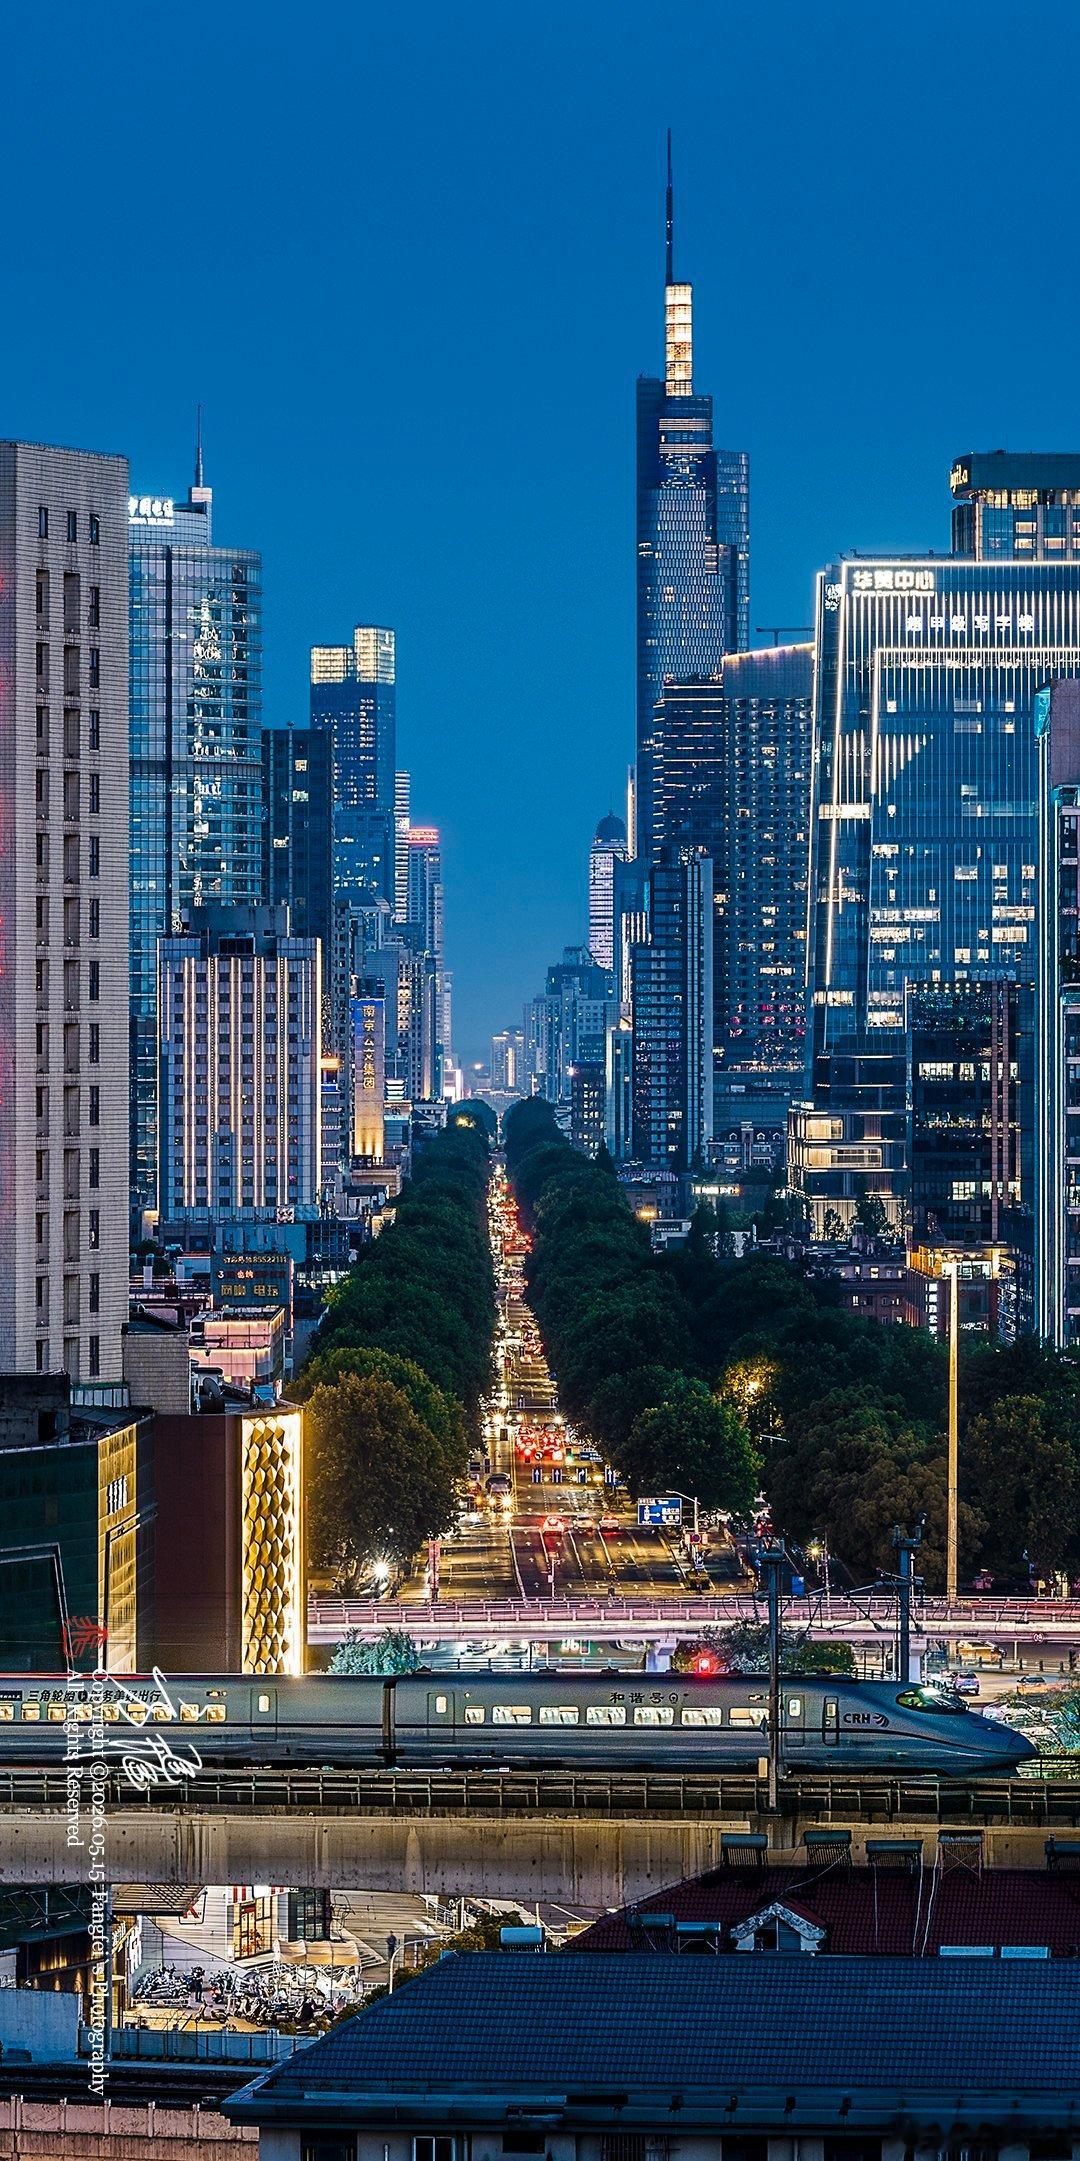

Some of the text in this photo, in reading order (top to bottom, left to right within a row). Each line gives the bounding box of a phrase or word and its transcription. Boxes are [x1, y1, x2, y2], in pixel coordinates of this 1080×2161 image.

[853, 570, 934, 589] 华贸中心
[609, 1691, 664, 1704] 和谐号
[843, 1713, 870, 1724] CRH
